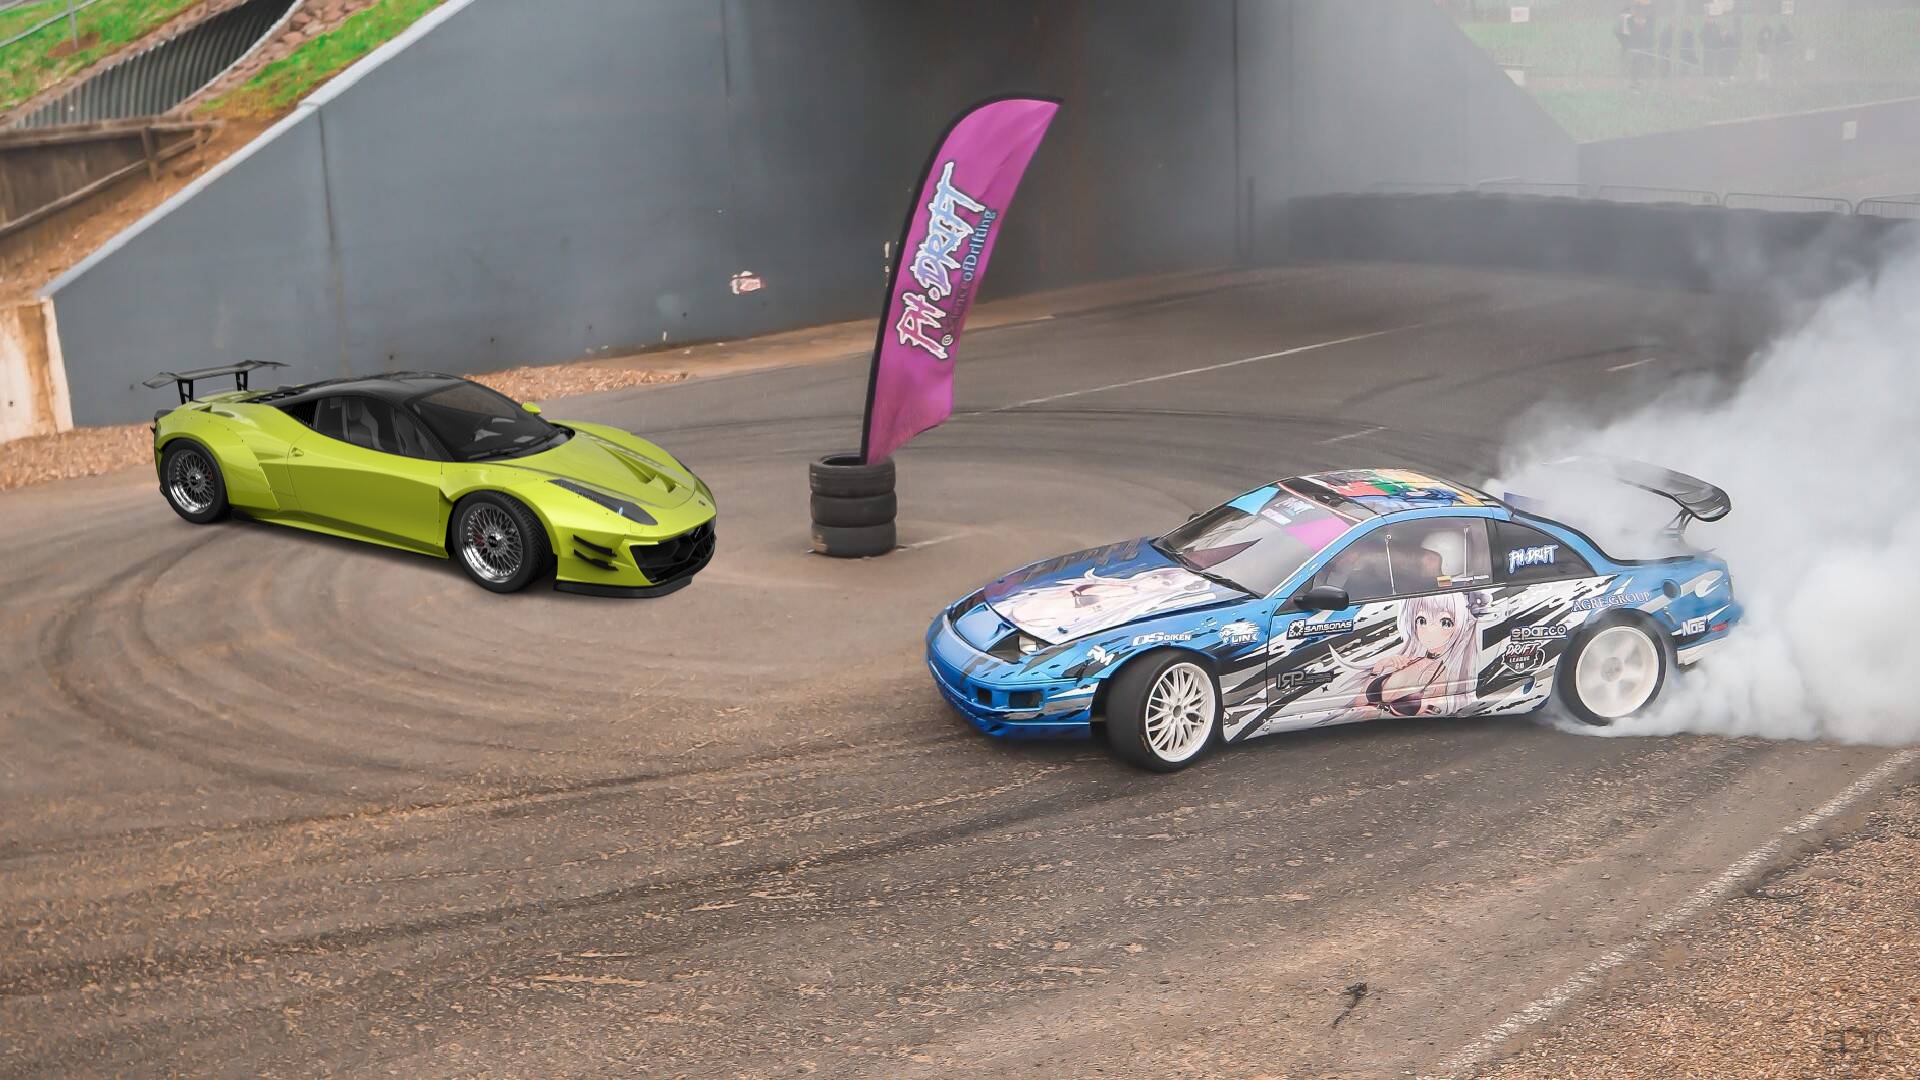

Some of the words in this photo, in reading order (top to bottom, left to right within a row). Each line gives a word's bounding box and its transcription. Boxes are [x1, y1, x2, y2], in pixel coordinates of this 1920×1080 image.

[1608, 591, 1651, 606] GROUP
[1304, 621, 1352, 633] SAMSONAS
[1511, 625, 1567, 639] sparco
[1682, 615, 1707, 637] NOS
[1505, 642, 1542, 657] DRIFT
